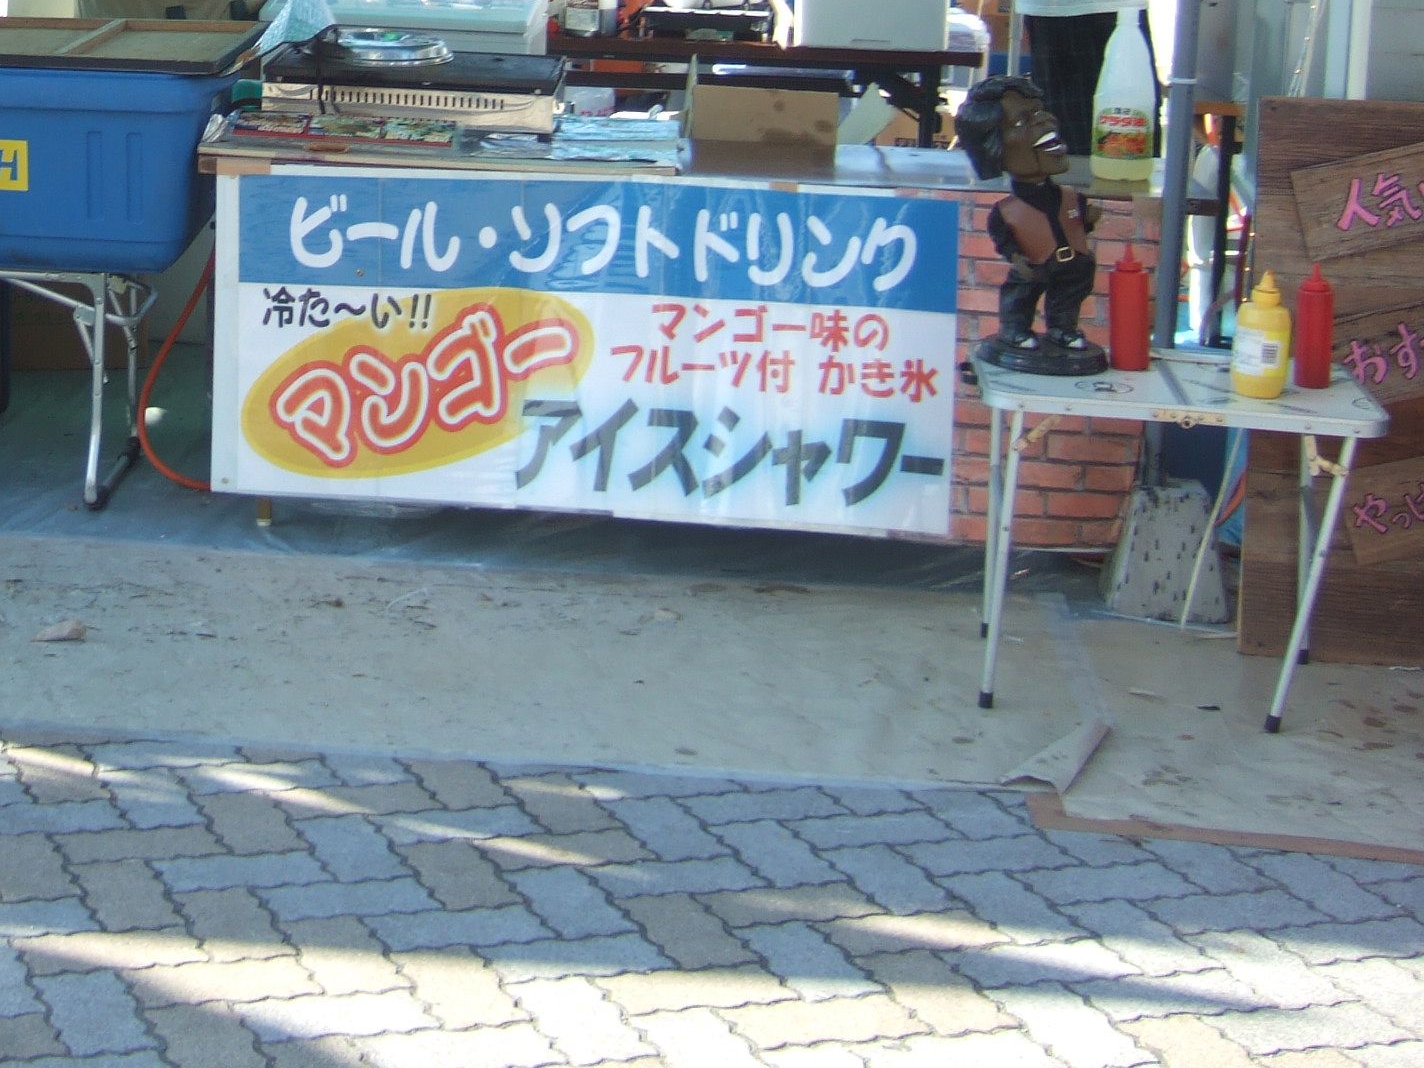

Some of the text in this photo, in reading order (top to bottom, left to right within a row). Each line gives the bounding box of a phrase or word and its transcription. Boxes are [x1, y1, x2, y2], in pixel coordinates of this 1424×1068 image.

[1337, 171, 1424, 230] 人気
[289, 193, 917, 291] ビール・ソフトドリンク
[651, 302, 891, 353] マンゴー味の
[1344, 320, 1424, 385] おす
[269, 303, 582, 469] マンゴー
[610, 345, 939, 404] フルーツ付 かき氷
[516, 397, 945, 509] アイスシャワー
